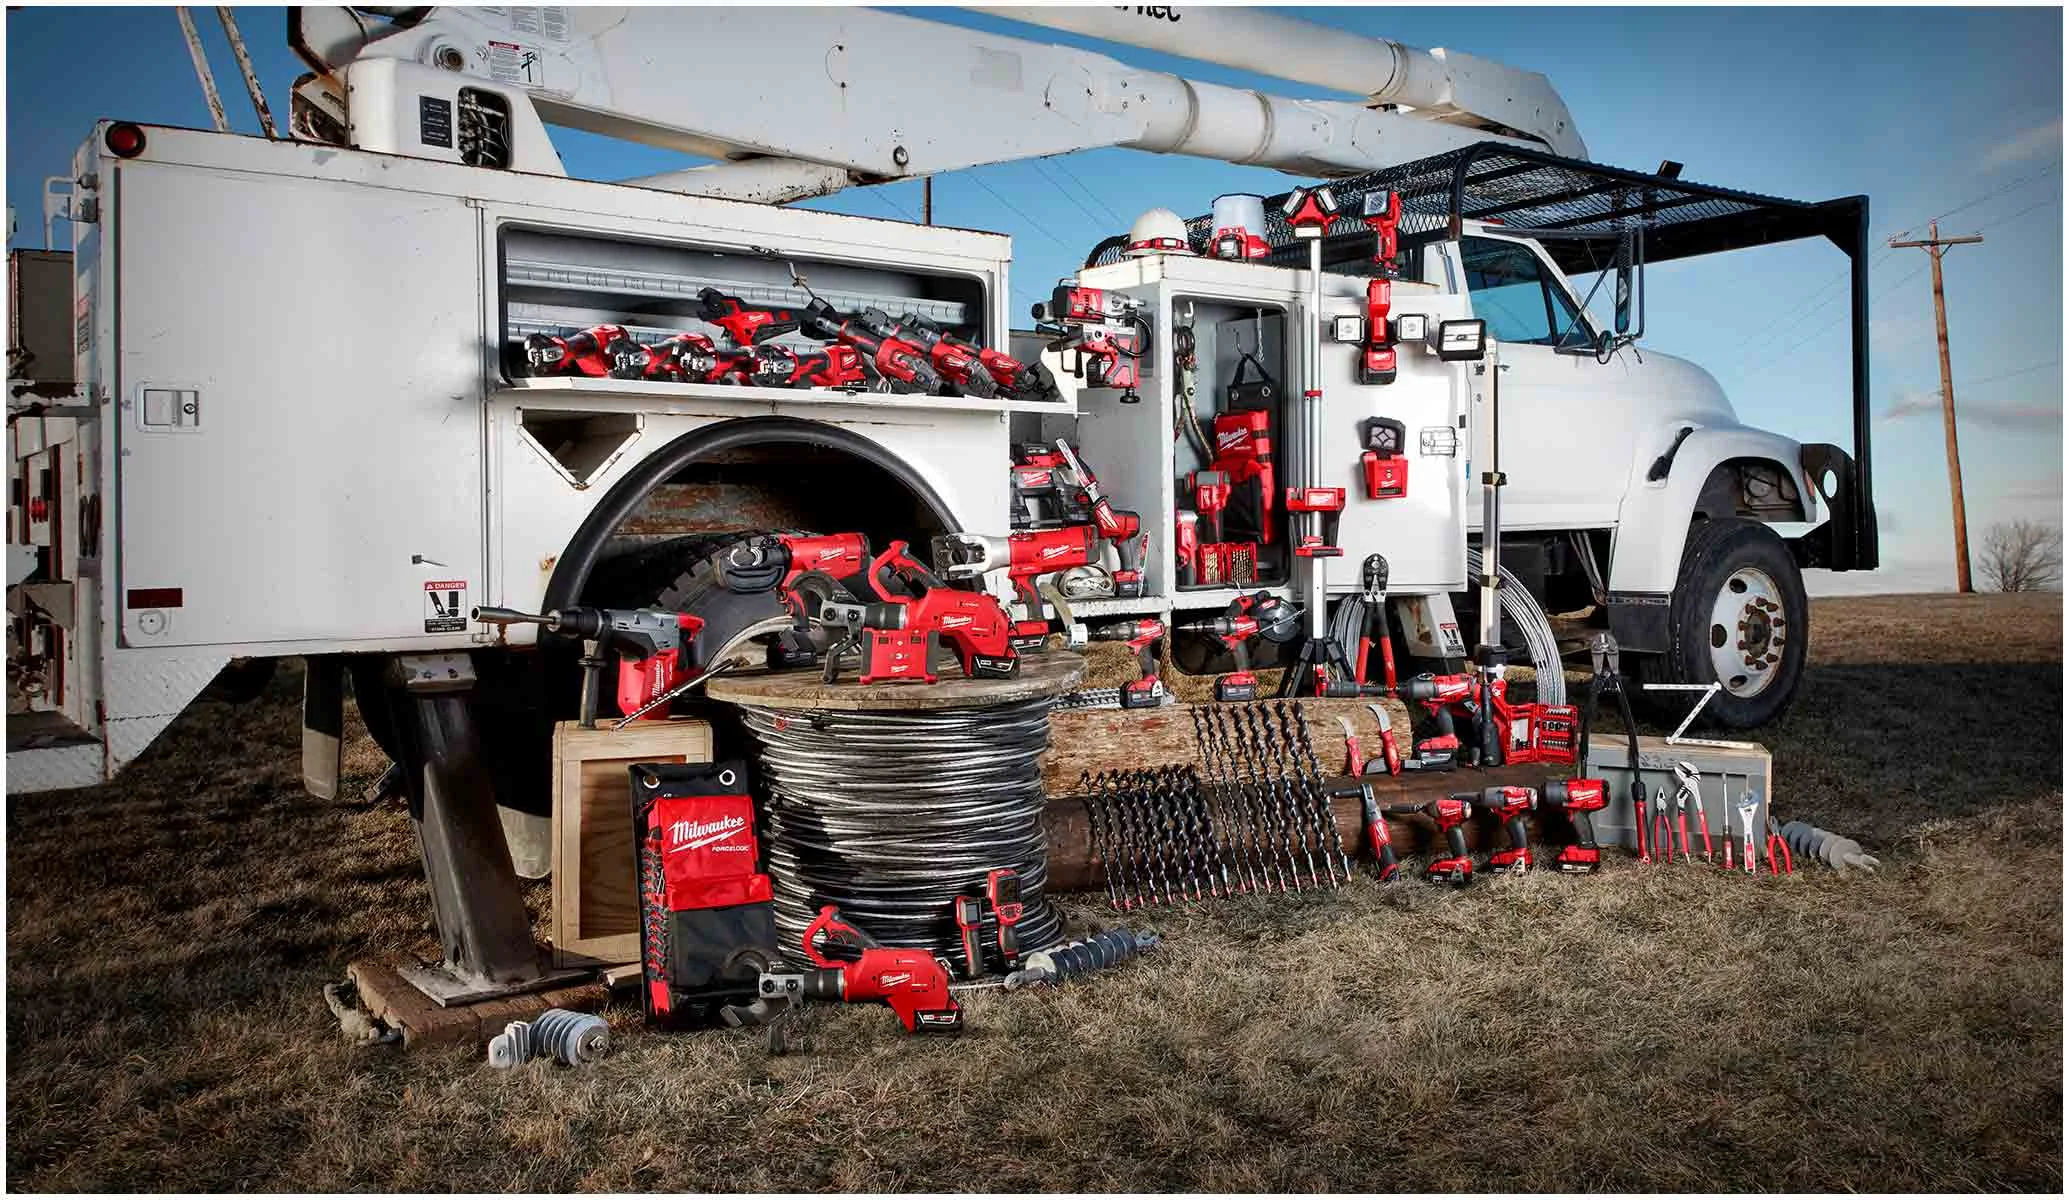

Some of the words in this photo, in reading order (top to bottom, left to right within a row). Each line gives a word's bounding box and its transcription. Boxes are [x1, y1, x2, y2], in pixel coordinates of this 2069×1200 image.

[942, 615, 973, 626] Milwaukee
[667, 815, 746, 846] Milwaukee
[880, 972, 911, 984] Milwaukee
